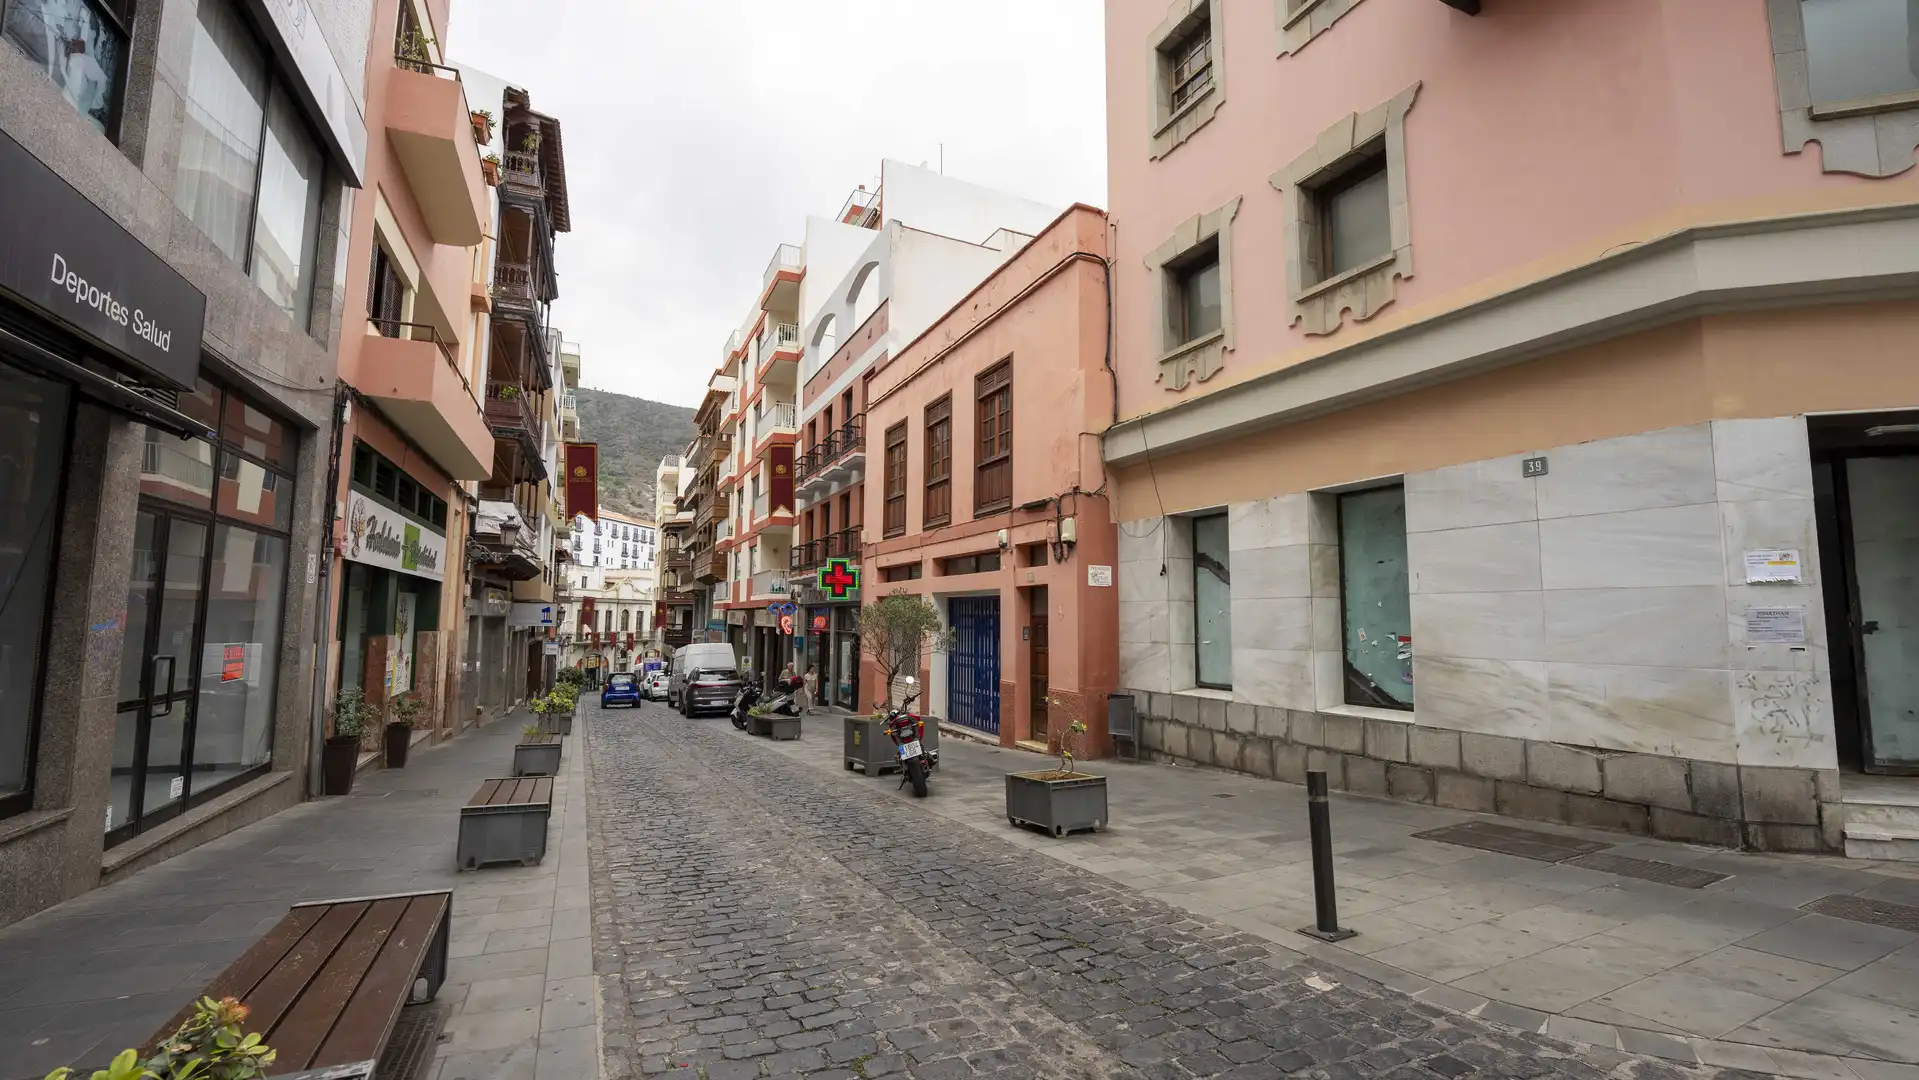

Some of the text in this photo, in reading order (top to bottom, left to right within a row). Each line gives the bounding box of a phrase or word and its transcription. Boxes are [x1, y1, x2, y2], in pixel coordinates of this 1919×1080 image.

[51, 253, 171, 352] Deportes Salud
[1528, 460, 1542, 473] 39
